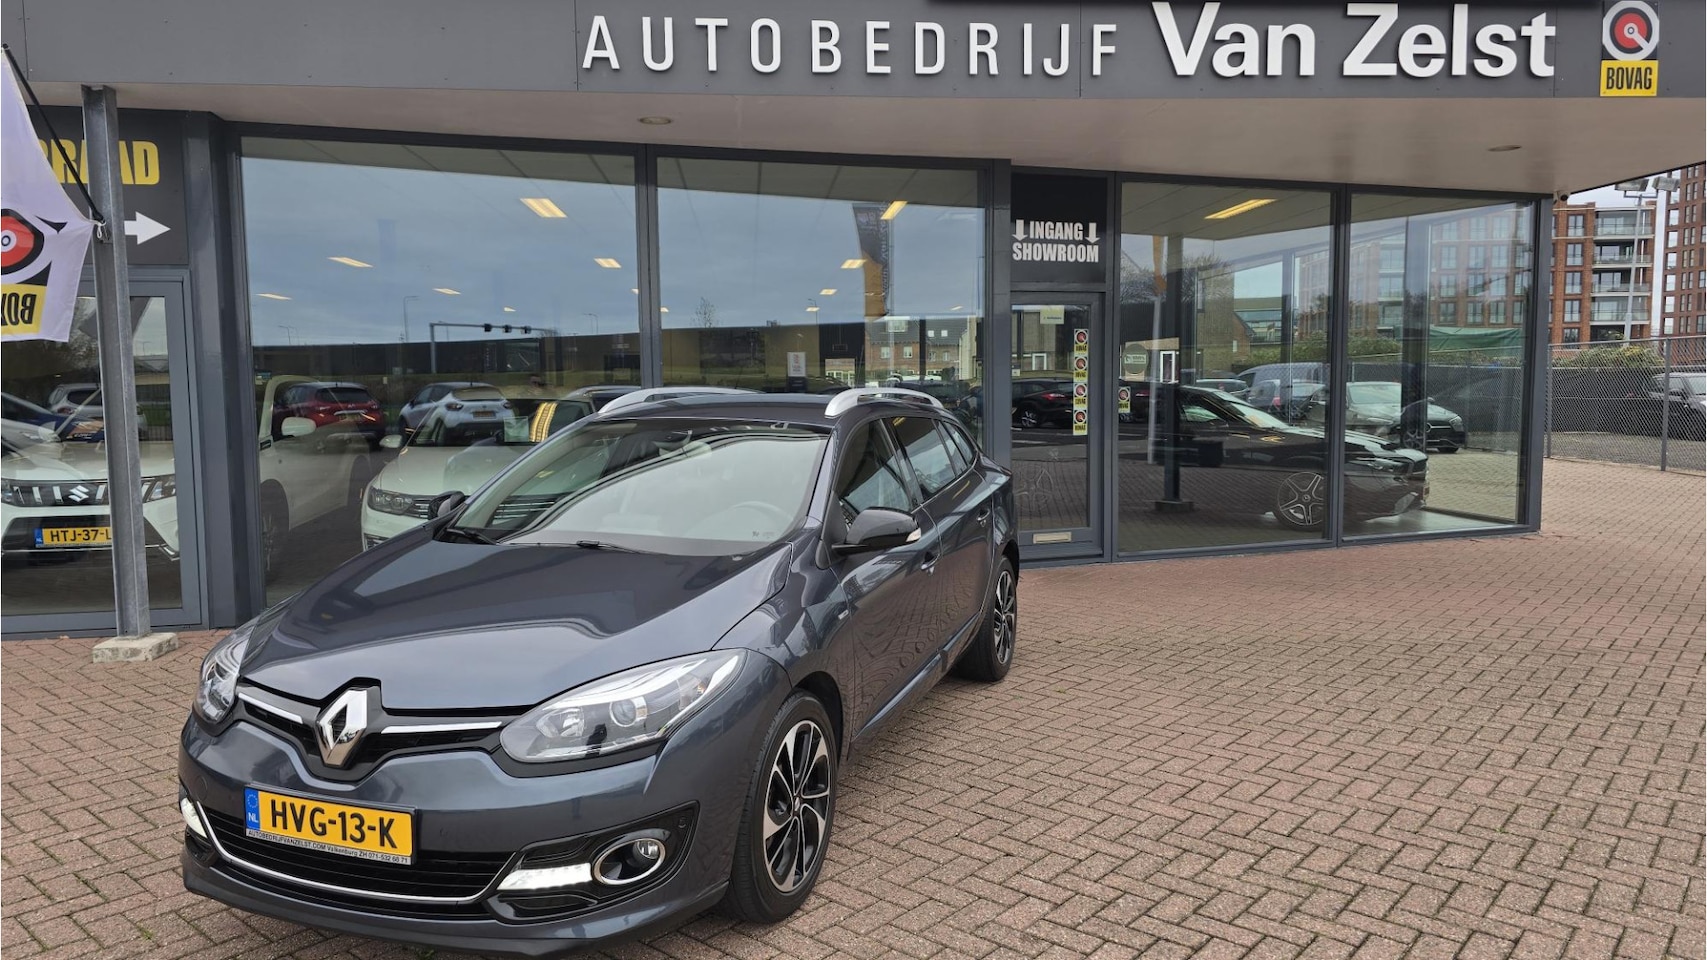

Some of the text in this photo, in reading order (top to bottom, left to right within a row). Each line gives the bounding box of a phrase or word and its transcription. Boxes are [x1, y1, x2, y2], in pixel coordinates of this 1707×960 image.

[582, 1, 1557, 78] AUTOBEDRIJF Van Zelst
[1605, 66, 1653, 90] BOVAG
[1029, 220, 1084, 241] INGANG
[1012, 241, 1099, 263] SHOWROOM
[49, 528, 112, 543] HTJ-37-L
[247, 813, 259, 824] NL
[270, 798, 398, 849] HVG-13-K
[326, 845, 358, 857] Valkenburg
[358, 850, 368, 858] ZH
